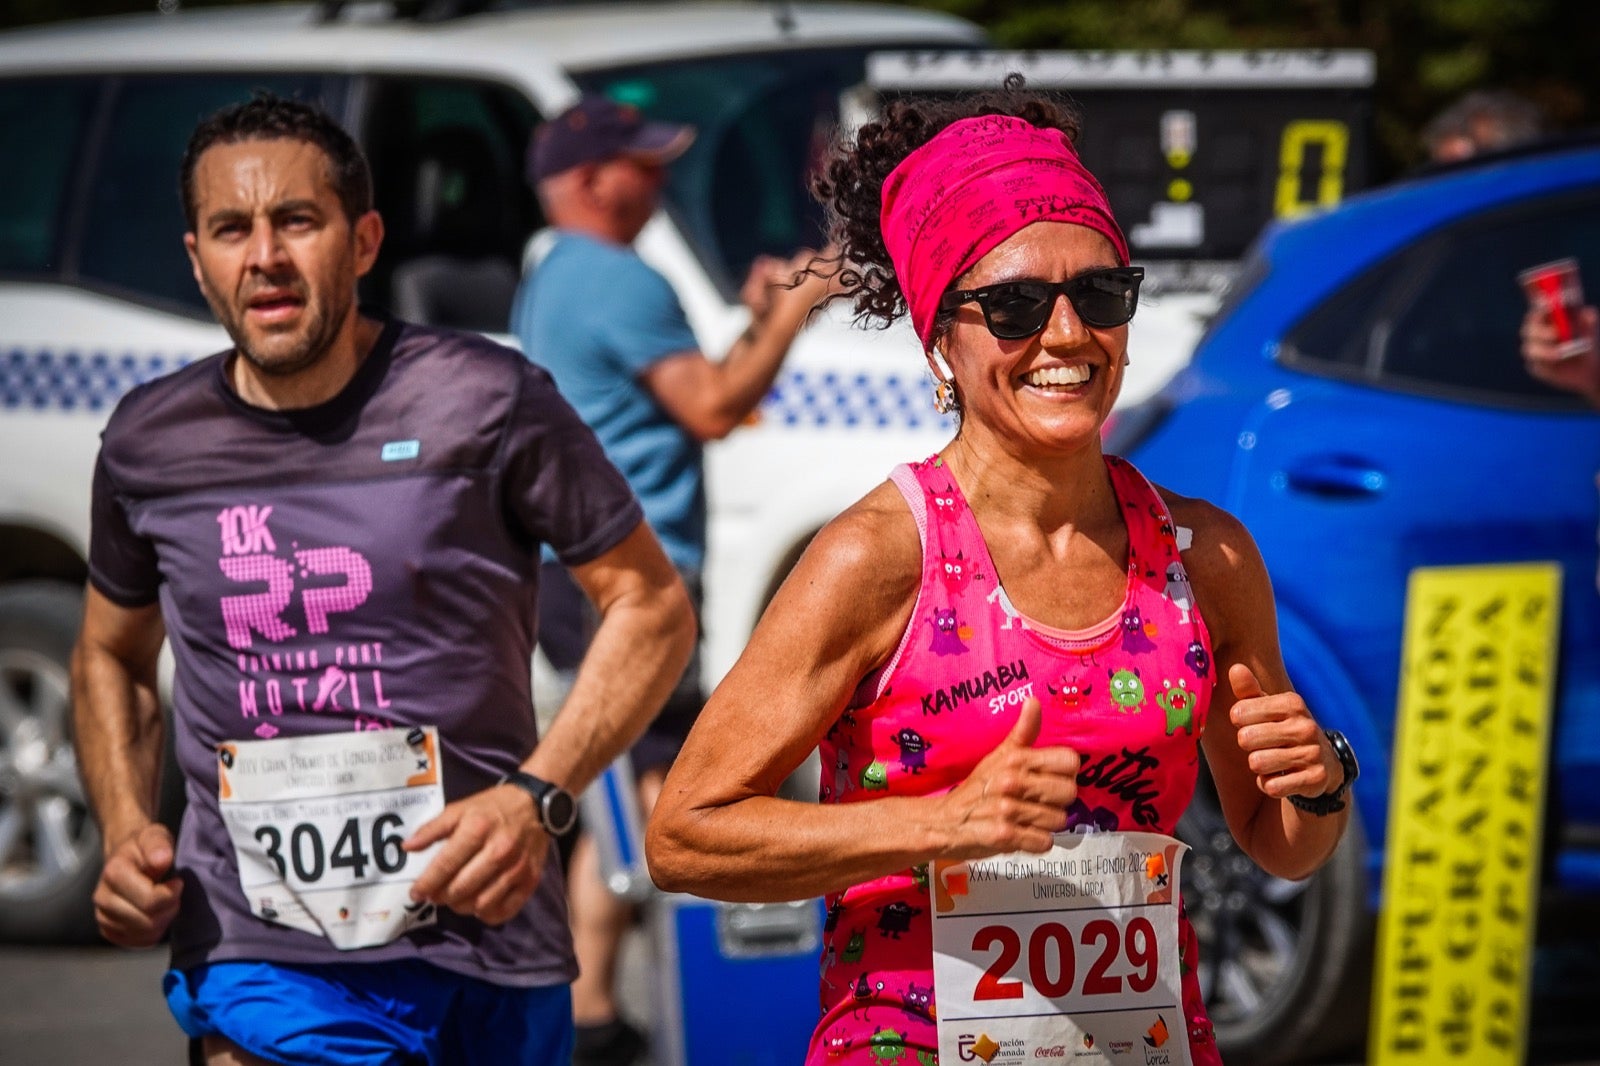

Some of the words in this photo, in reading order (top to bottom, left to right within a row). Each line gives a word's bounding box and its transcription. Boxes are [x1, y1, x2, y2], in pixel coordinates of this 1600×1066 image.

[217, 505, 277, 555] 10K
[920, 659, 1030, 717] KAMUABU
[988, 681, 1034, 715] SPORT
[1446, 595, 1506, 962] GRANADA
[254, 812, 408, 884] 3046
[968, 861, 999, 882] XXXV
[971, 916, 1159, 1001] 2029
